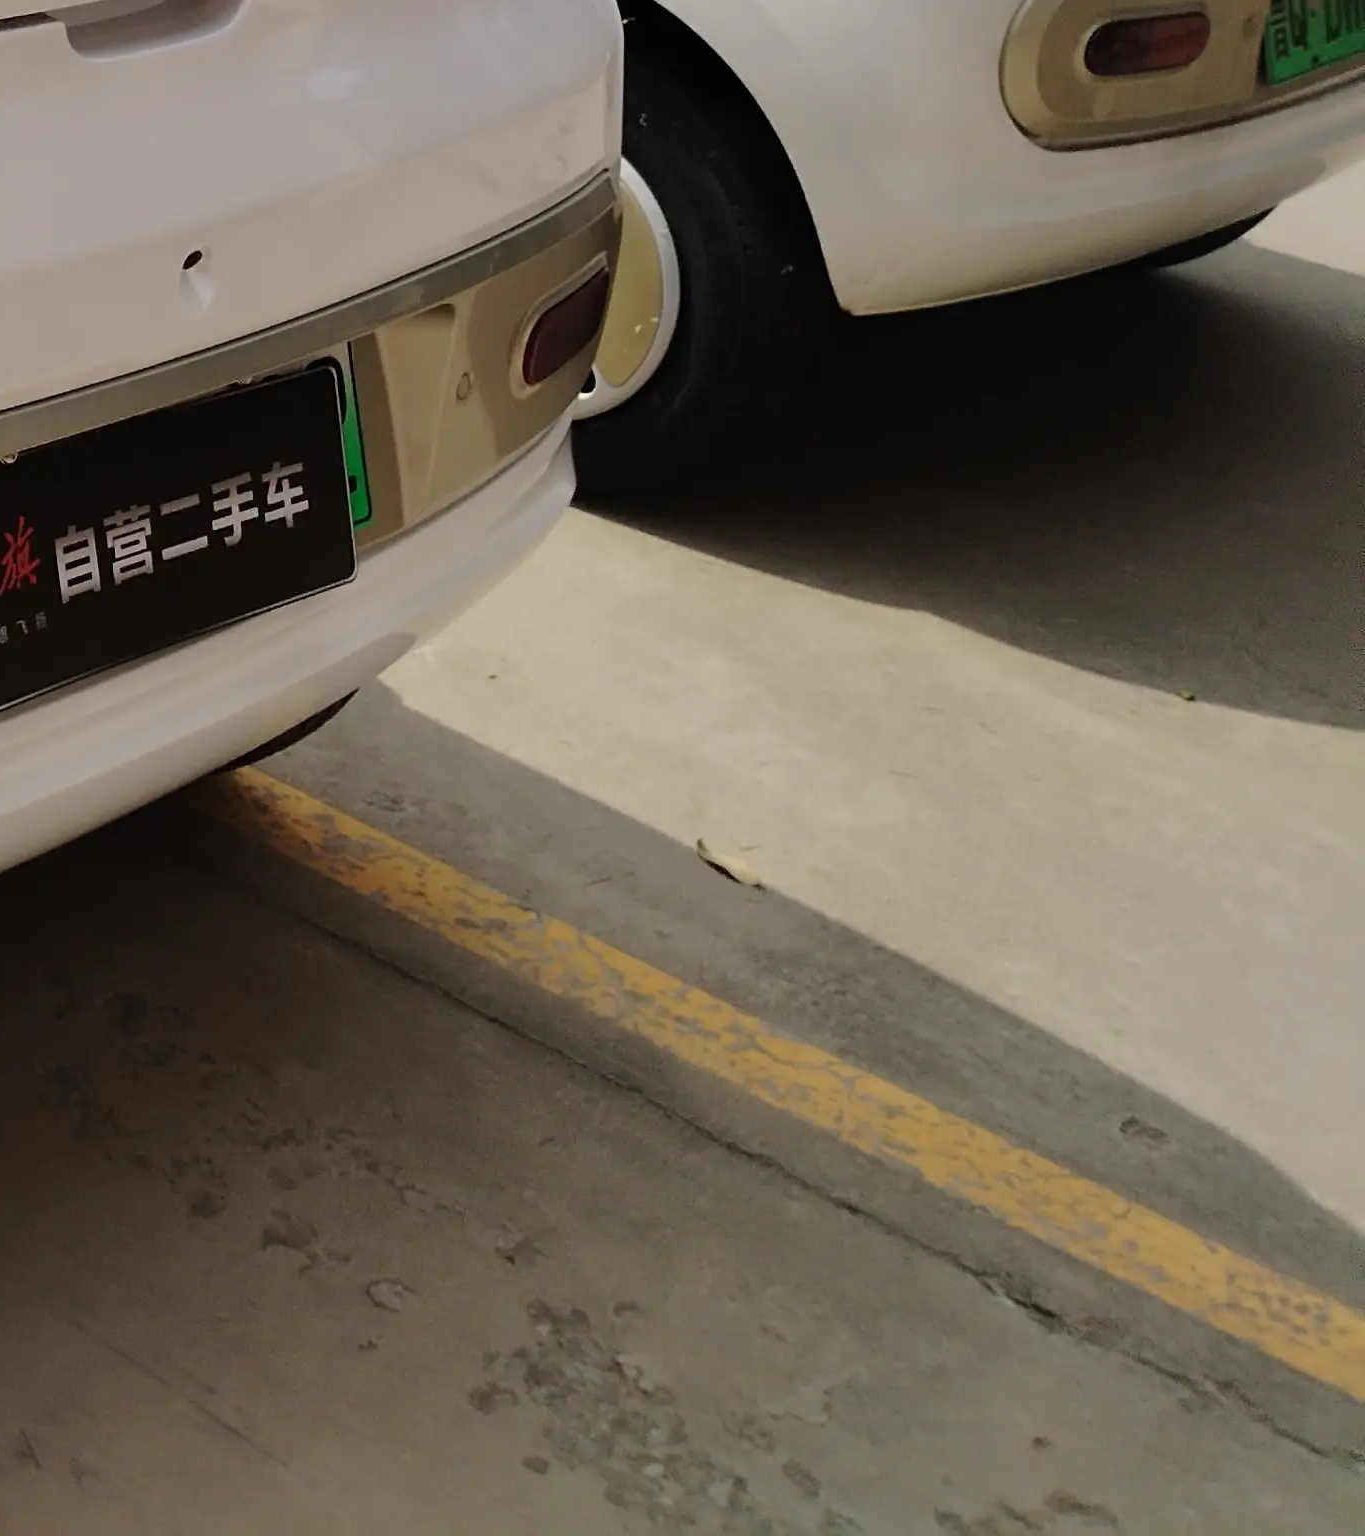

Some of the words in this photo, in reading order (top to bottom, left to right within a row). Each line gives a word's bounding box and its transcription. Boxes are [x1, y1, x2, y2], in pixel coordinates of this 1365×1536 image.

[54, 460, 311, 604] 自营二手车
